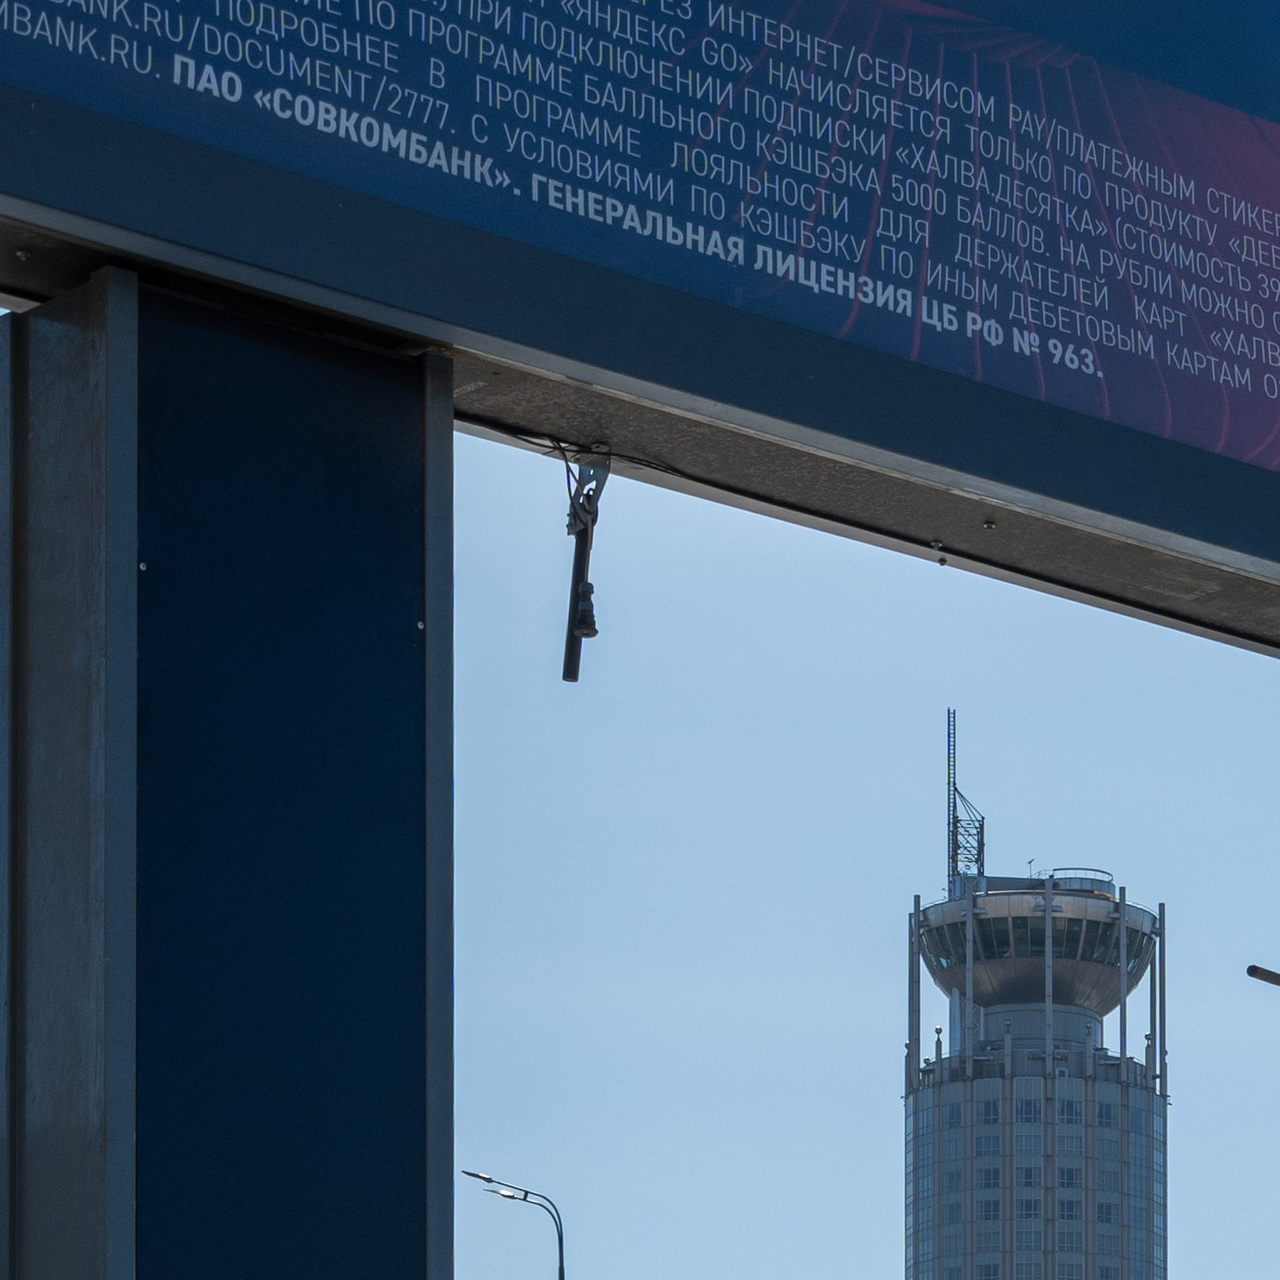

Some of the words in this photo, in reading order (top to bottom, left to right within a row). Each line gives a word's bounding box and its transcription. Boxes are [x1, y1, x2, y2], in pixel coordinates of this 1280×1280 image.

[173, 54, 242, 102] ПАО
[254, 88, 520, 196] «СОВКОМБАНК».
[532, 173, 744, 265] ГЕНЕРАЛЬНАЯ
[754, 244, 912, 317] ЛИЦЕНЗИЯ
[922, 296, 958, 332] ЦБ
[966, 311, 1004, 346] РФ
[1013, 327, 1040, 356] №
[1048, 339, 1103, 378] 963.
[409, 8, 572, 96] ПРОГРАММЕ
[585, 74, 745, 150] БАЛЛЬНОГО
[757, 130, 881, 196] КЭШБЭКА
[892, 174, 946, 215] 5000
[957, 195, 1049, 256] БАЛЛОВ.
[1060, 236, 1090, 270] НА
[1100, 249, 1172, 298] РУБЛИ
[1181, 279, 1264, 328] МОЖНО
[430, 57, 445, 89] В
[476, 75, 641, 158] ПРОГРАММЕ
[671, 142, 848, 223] ЛОЯЛЬНОСТИ
[876, 208, 929, 248] ДЛЯ
[955, 233, 1108, 310] ДЕРЖАТЕЛЕЙ
[1134, 295, 1186, 336] КАРТ
[522, 12, 732, 109] ПОДКЛЮЧЕНИИ
[745, 87, 885, 160] ПОДПИСКИ
[896, 143, 1107, 236] «ХАЛВА.ДЕСЯТКА»
[1116, 217, 1251, 291] (СТОИМОСТЬ
[702, 37, 753, 73] GO»
[769, 58, 950, 144] НАЧИСЛЯЕТСЯ
[965, 124, 1051, 182] ТОЛЬКО
[1064, 165, 1091, 199] ПО
[1106, 182, 1217, 245] ПРОДУКТУ
[708, 0, 994, 122] ИНТЕРНЕТ/СЕРВИСОМ
[1009, 103, 1195, 204] PAY/ПЛАТЕЖНЫМ
[472, 114, 488, 143] С
[503, 123, 673, 205] УСЛОВИЯМИ
[691, 185, 725, 220] ПО
[741, 201, 866, 263] КЭШБЭКУ
[881, 245, 913, 278] ПО
[927, 260, 997, 309] ИНЫМ
[1009, 291, 1154, 359] ДЕБЕТОВЫМ
[1167, 341, 1251, 391] КАРТАМ
